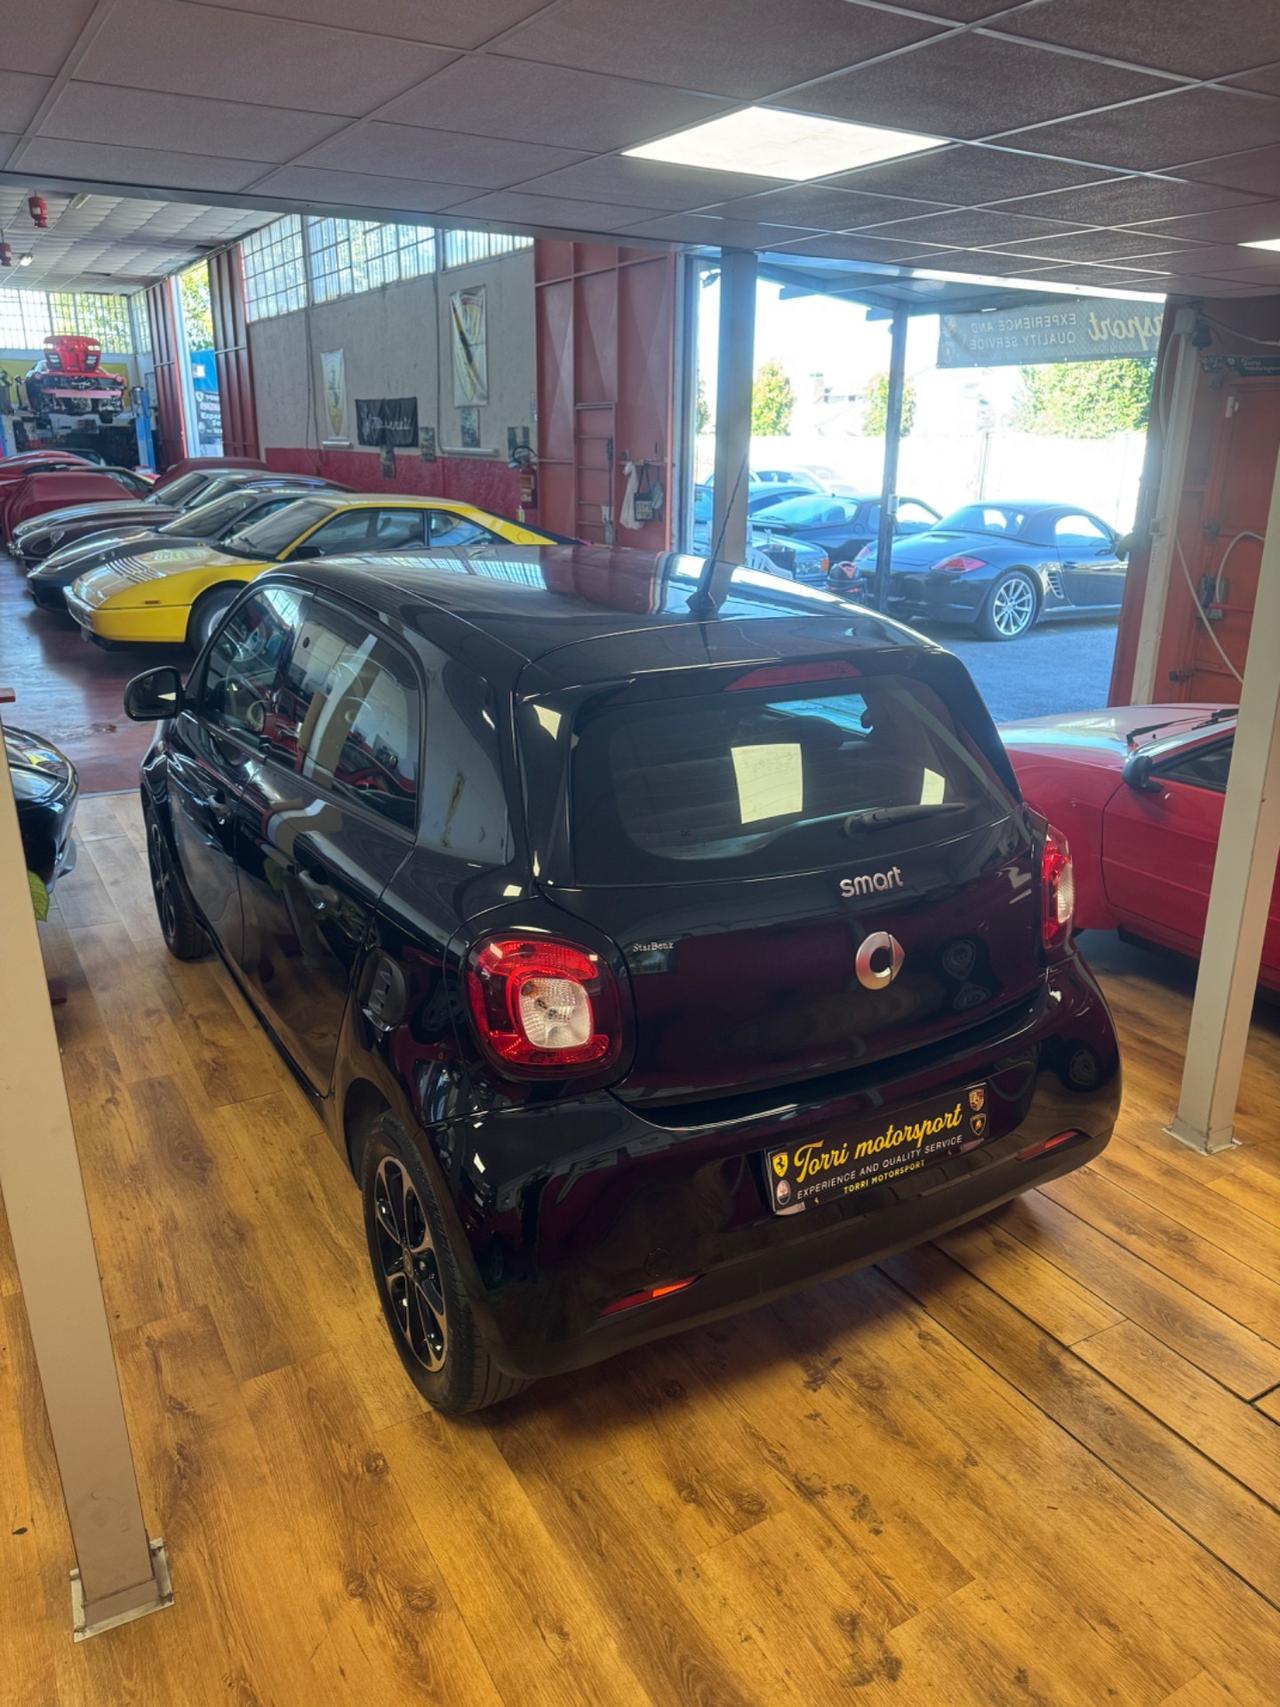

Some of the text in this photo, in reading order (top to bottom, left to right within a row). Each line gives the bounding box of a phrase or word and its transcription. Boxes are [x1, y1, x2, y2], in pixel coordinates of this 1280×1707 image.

[839, 866, 904, 898] smart
[632, 941, 675, 952] StarBenz
[793, 1103, 963, 1184] Torri motorsport
[796, 1134, 963, 1200] EXPERIENCE AND QUALITY SERVICE
[843, 1159, 926, 1195] TORRI MOTORSPORT
